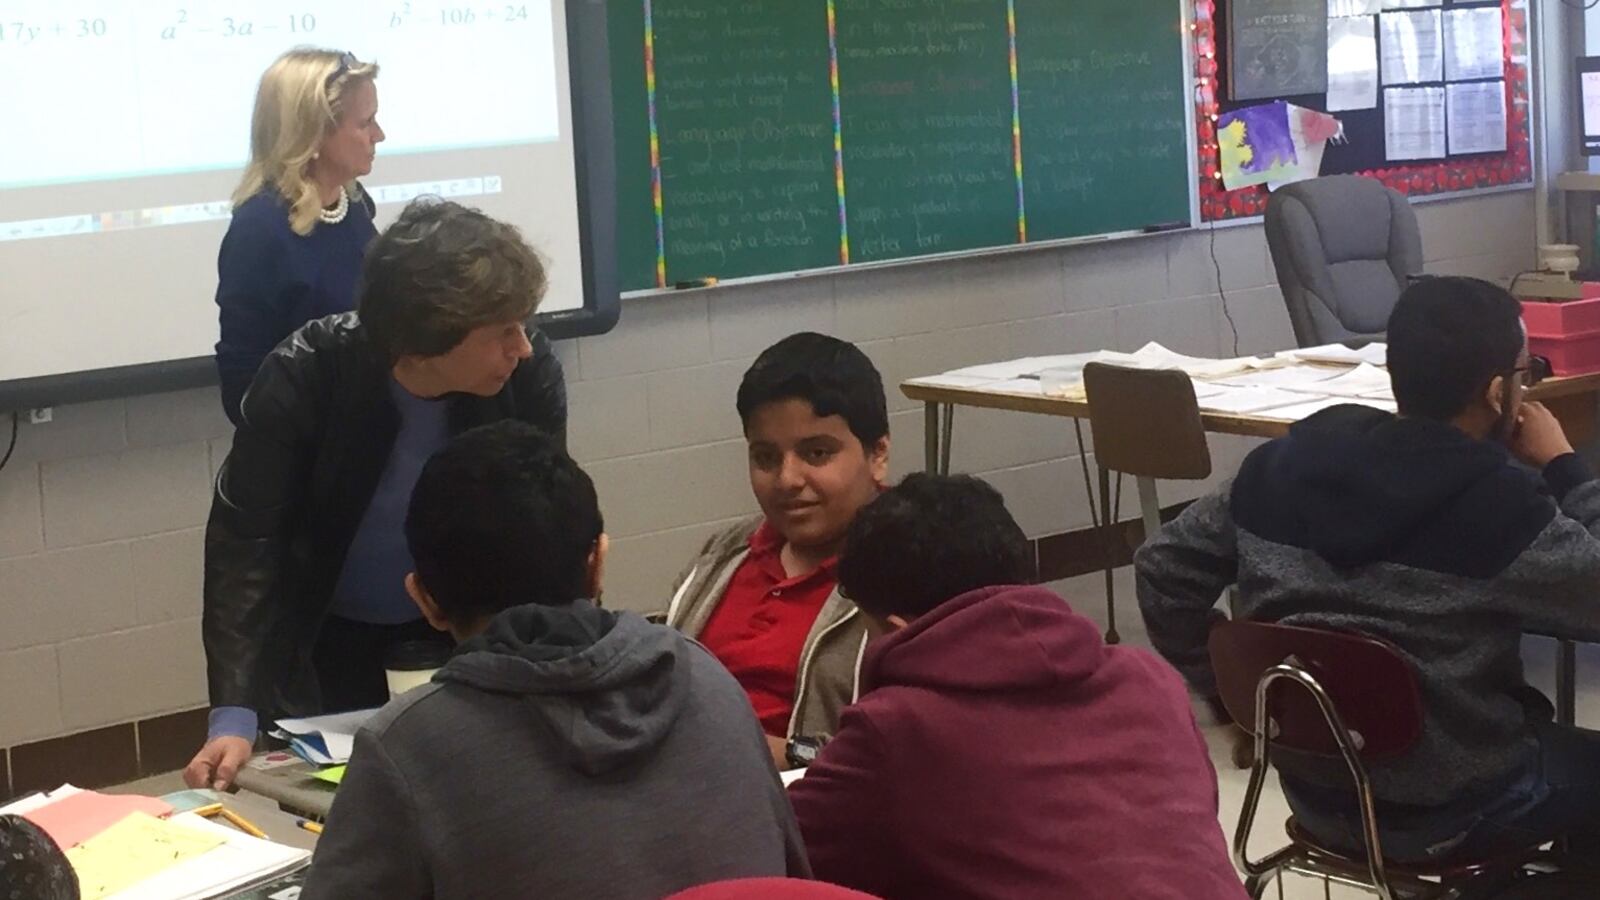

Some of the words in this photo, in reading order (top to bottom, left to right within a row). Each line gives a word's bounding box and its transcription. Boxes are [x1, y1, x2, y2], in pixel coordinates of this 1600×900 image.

[222, 17, 253, 37] 3a
[288, 13, 317, 33] 10
[441, 7, 476, 25] 10b
[504, 5, 528, 22] 24
[76, 18, 107, 38] 30
